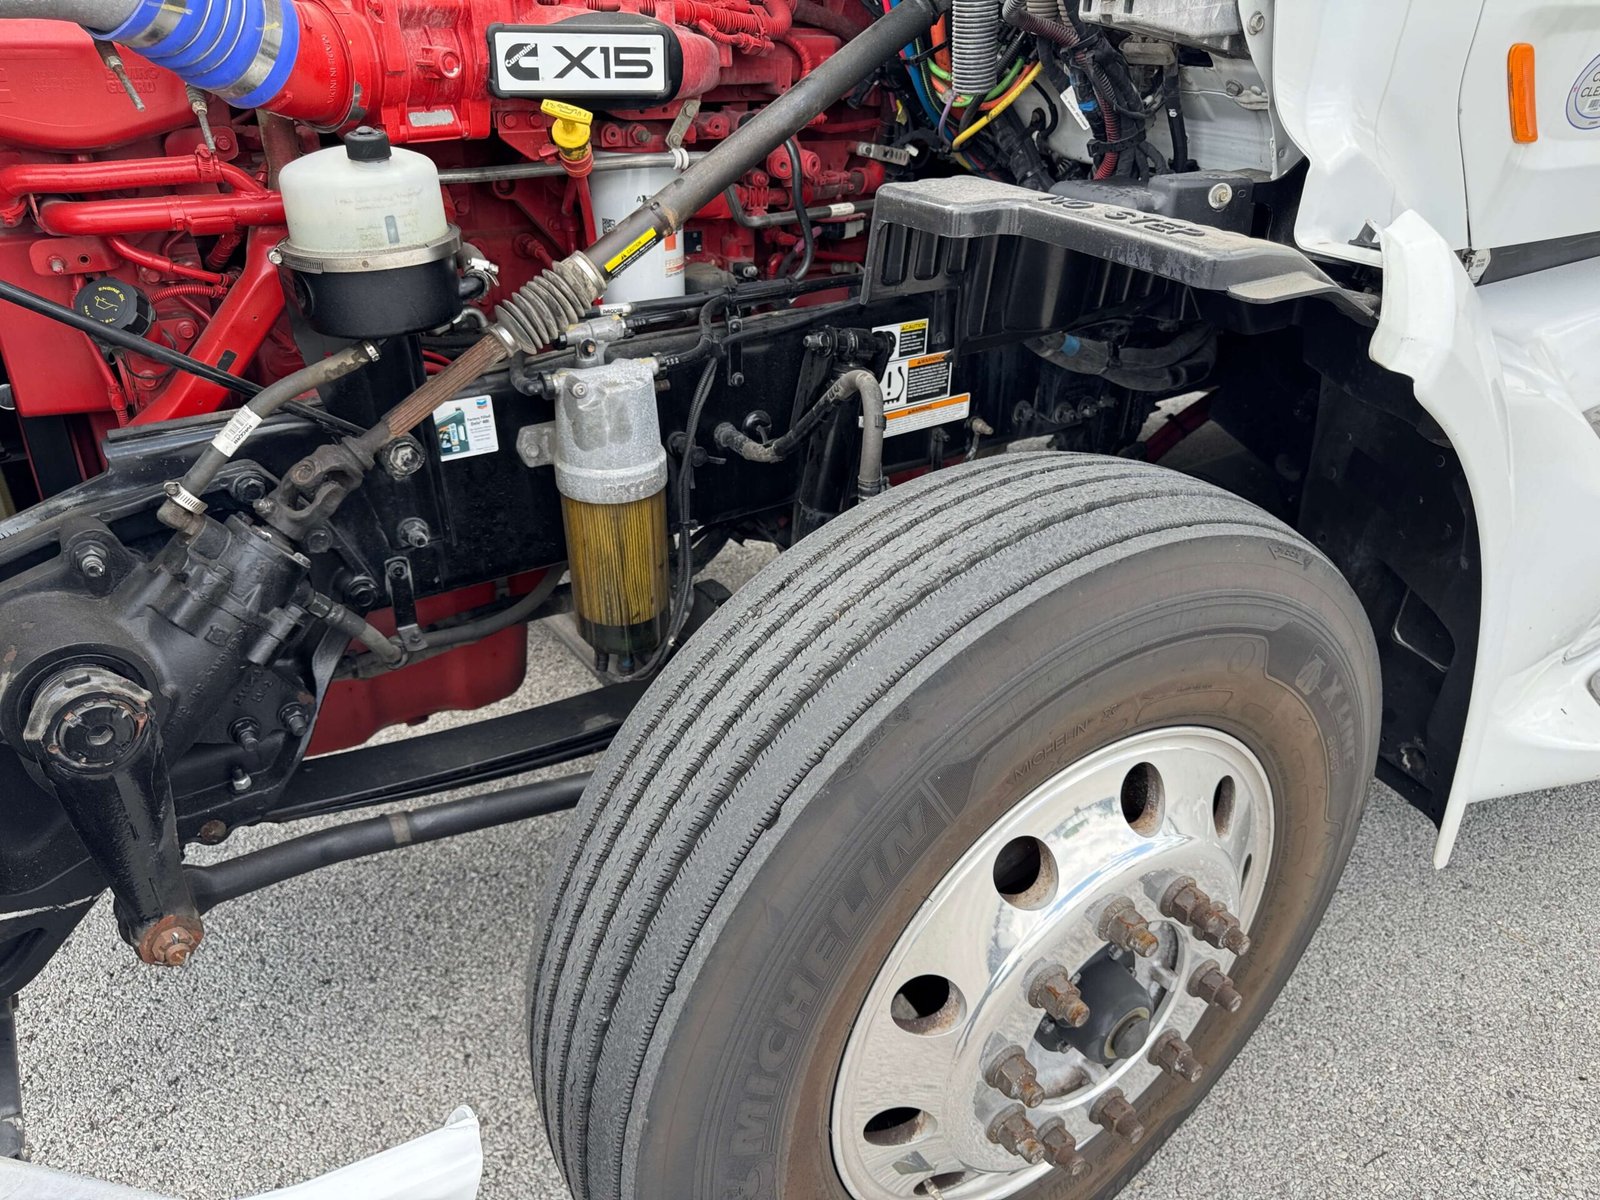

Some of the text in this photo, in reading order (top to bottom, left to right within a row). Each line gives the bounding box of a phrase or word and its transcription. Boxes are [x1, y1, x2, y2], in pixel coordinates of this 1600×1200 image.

[504, 43, 536, 68] Cummins
[552, 45, 654, 80] X15
[1038, 195, 1206, 238] NO STEP
[98, 286, 121, 295] ENGINE
[904, 322, 927, 331] CAUTION
[1012, 719, 1090, 781] MICHELIN
[728, 800, 928, 1155] MICHELIN
